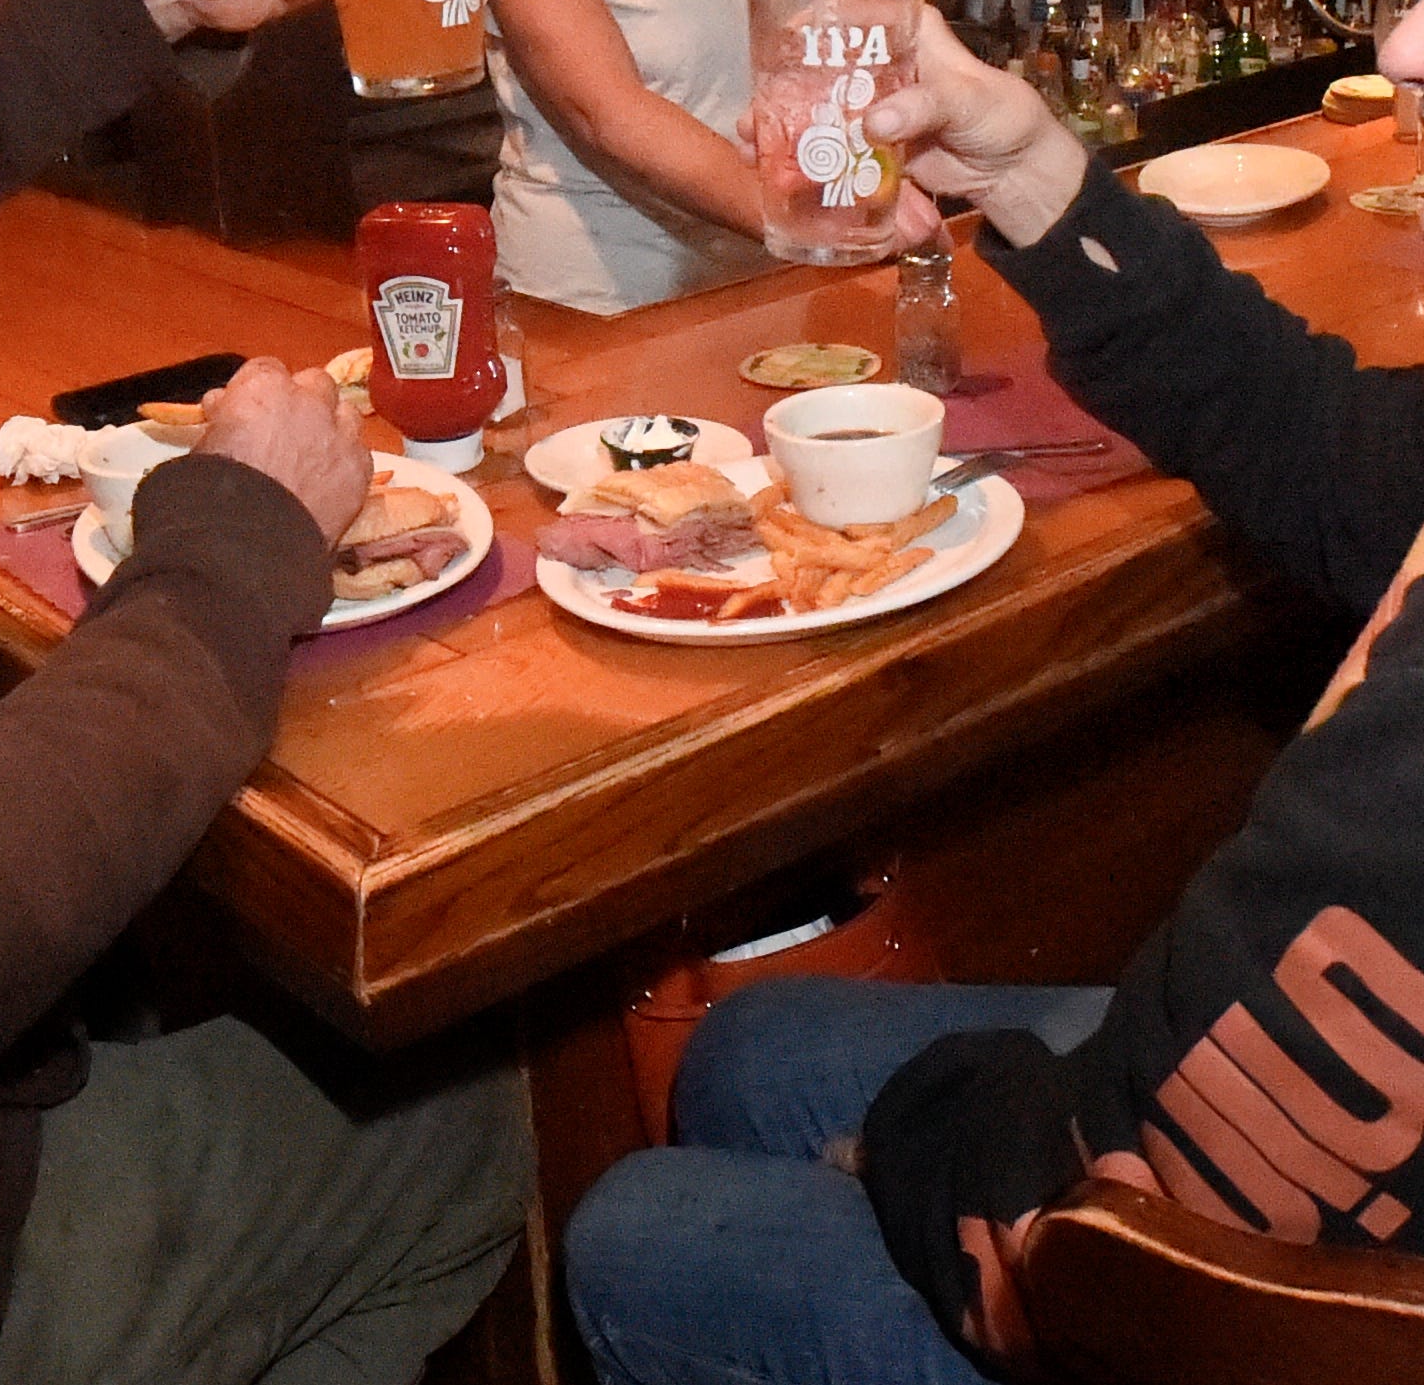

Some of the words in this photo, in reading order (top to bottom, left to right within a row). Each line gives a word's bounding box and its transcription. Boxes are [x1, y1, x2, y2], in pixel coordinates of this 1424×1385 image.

[801, 25, 892, 68] IPA
[394, 290, 434, 305] HEINZ
[395, 311, 442, 324] TOMATO
[399, 325, 441, 334] KETCHUP
